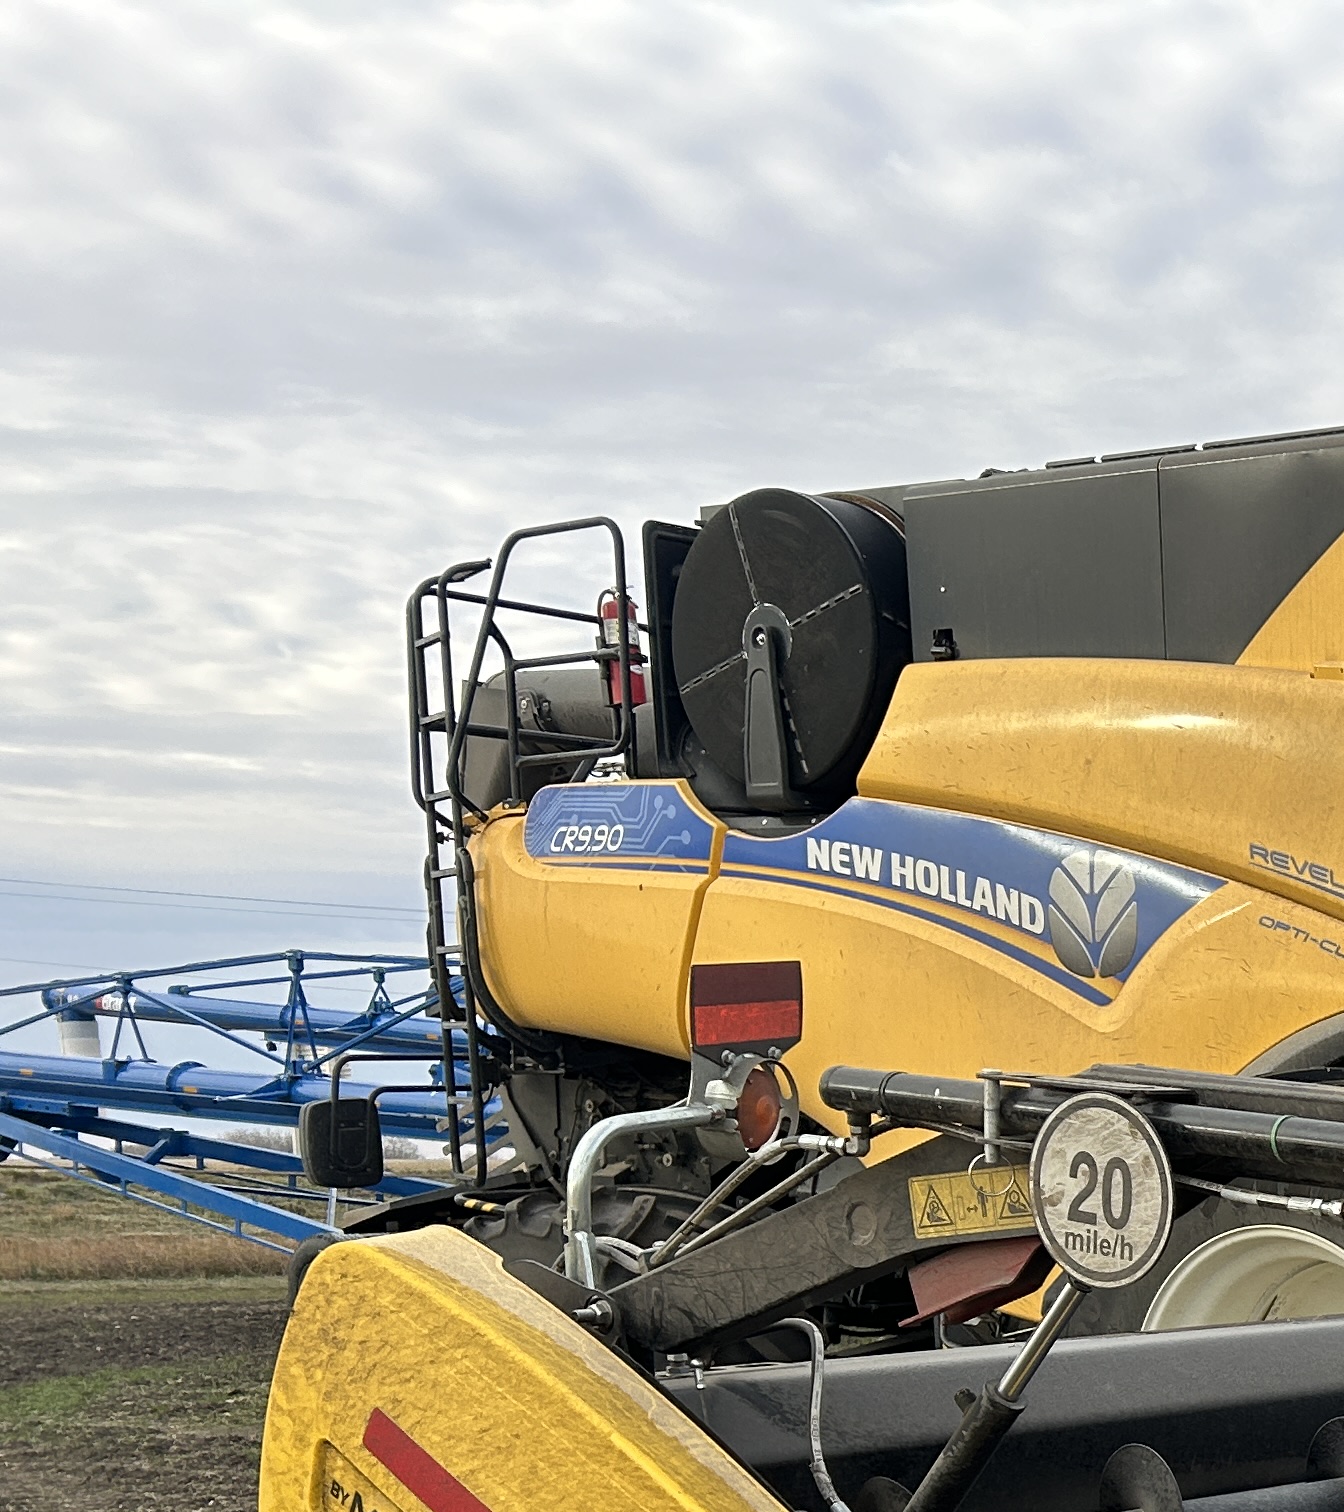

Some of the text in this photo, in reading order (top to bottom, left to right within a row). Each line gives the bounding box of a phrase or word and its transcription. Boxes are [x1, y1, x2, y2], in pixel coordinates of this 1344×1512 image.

[549, 823, 625, 853] CR9.90
[806, 836, 1046, 936] NEW HOLLAND
[1067, 1150, 1133, 1230] 20
[1064, 1229, 1134, 1262] mile/h
[330, 1479, 351, 1506] BY
